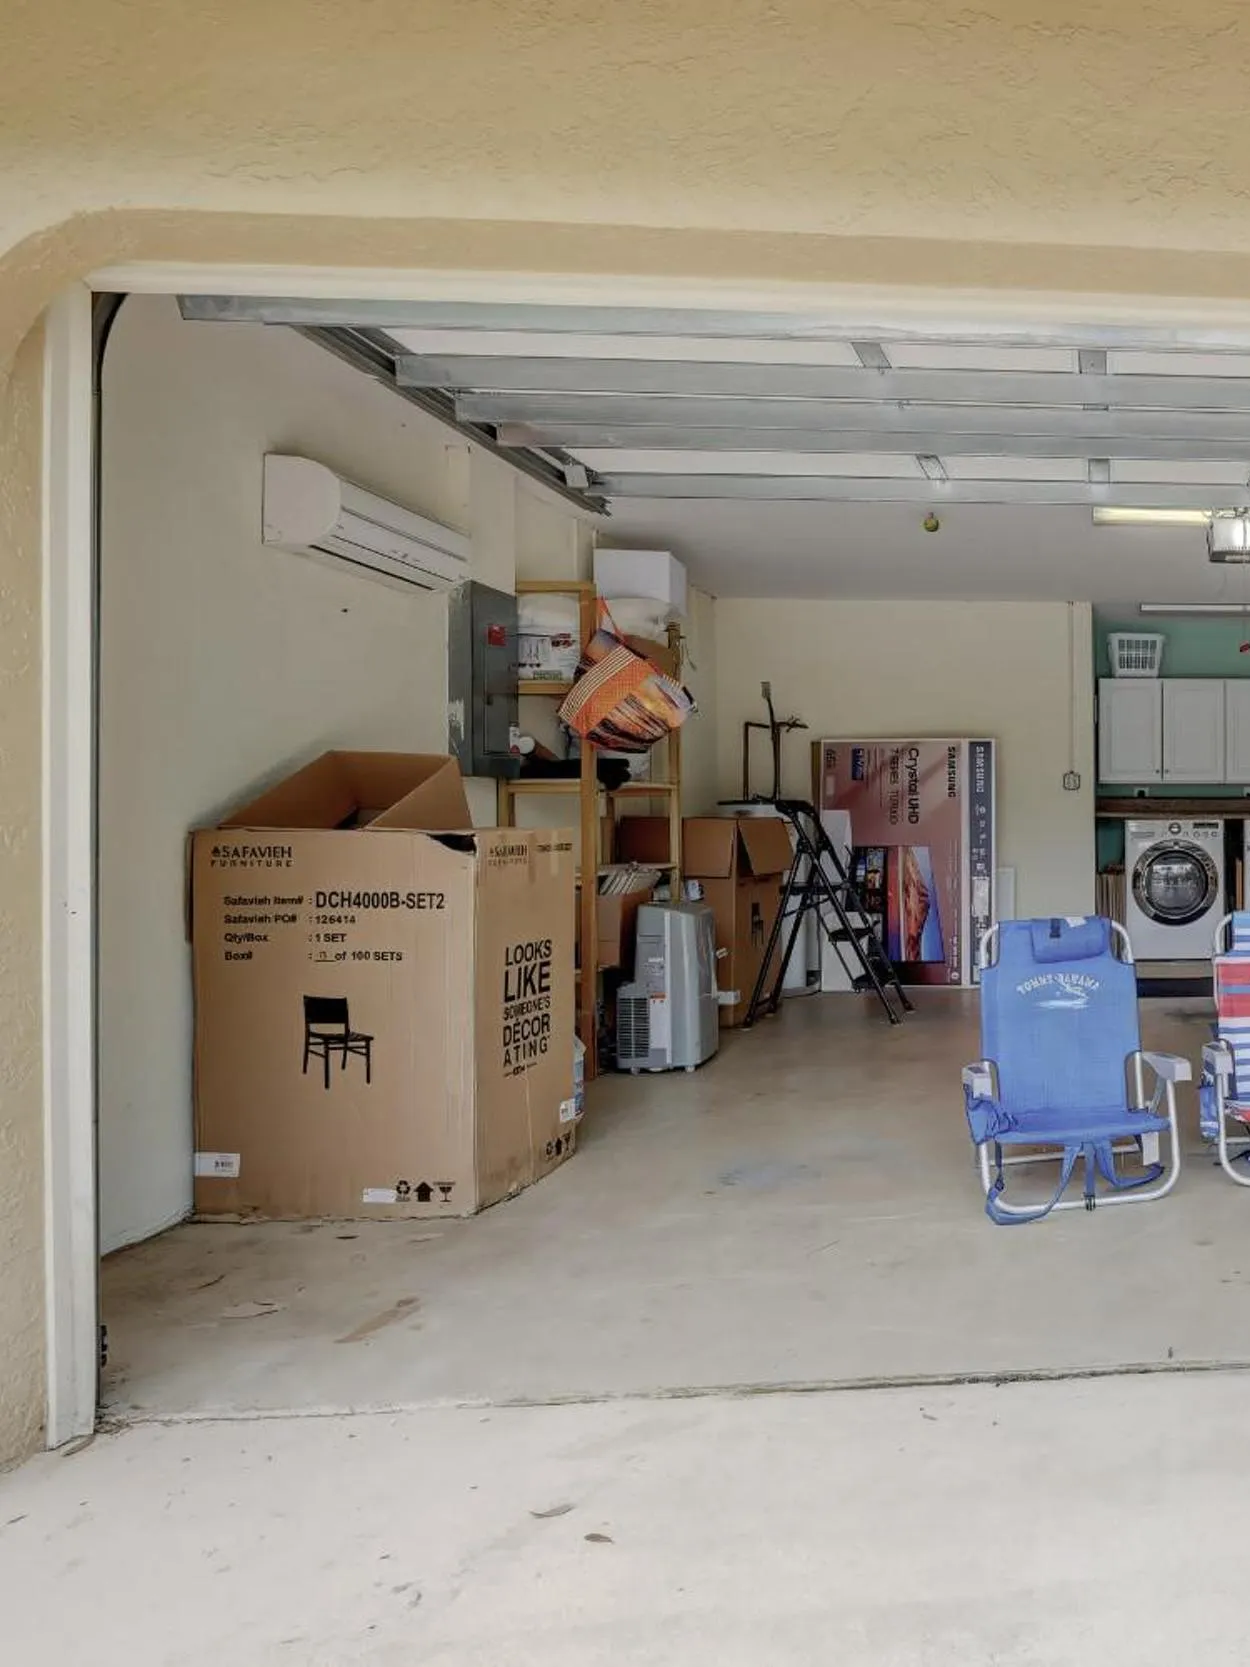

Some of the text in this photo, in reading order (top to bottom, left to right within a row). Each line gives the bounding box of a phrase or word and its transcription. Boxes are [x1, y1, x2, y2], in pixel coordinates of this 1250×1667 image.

[947, 746, 957, 798] SAMSUNG
[975, 746, 985, 793] SAMSUNG
[905, 748, 920, 825] Crystal UHD
[211, 859, 293, 868] FURNITURE
[222, 846, 292, 858] SAFAVIEH
[315, 891, 445, 910] DCH4000B-SET2
[323, 933, 347, 943] SET
[334, 951, 347, 961] of
[374, 951, 403, 961] SETS
[504, 939, 553, 967] LOOKS
[503, 960, 552, 1003] LIKE
[503, 1036, 548, 1068] ATING
